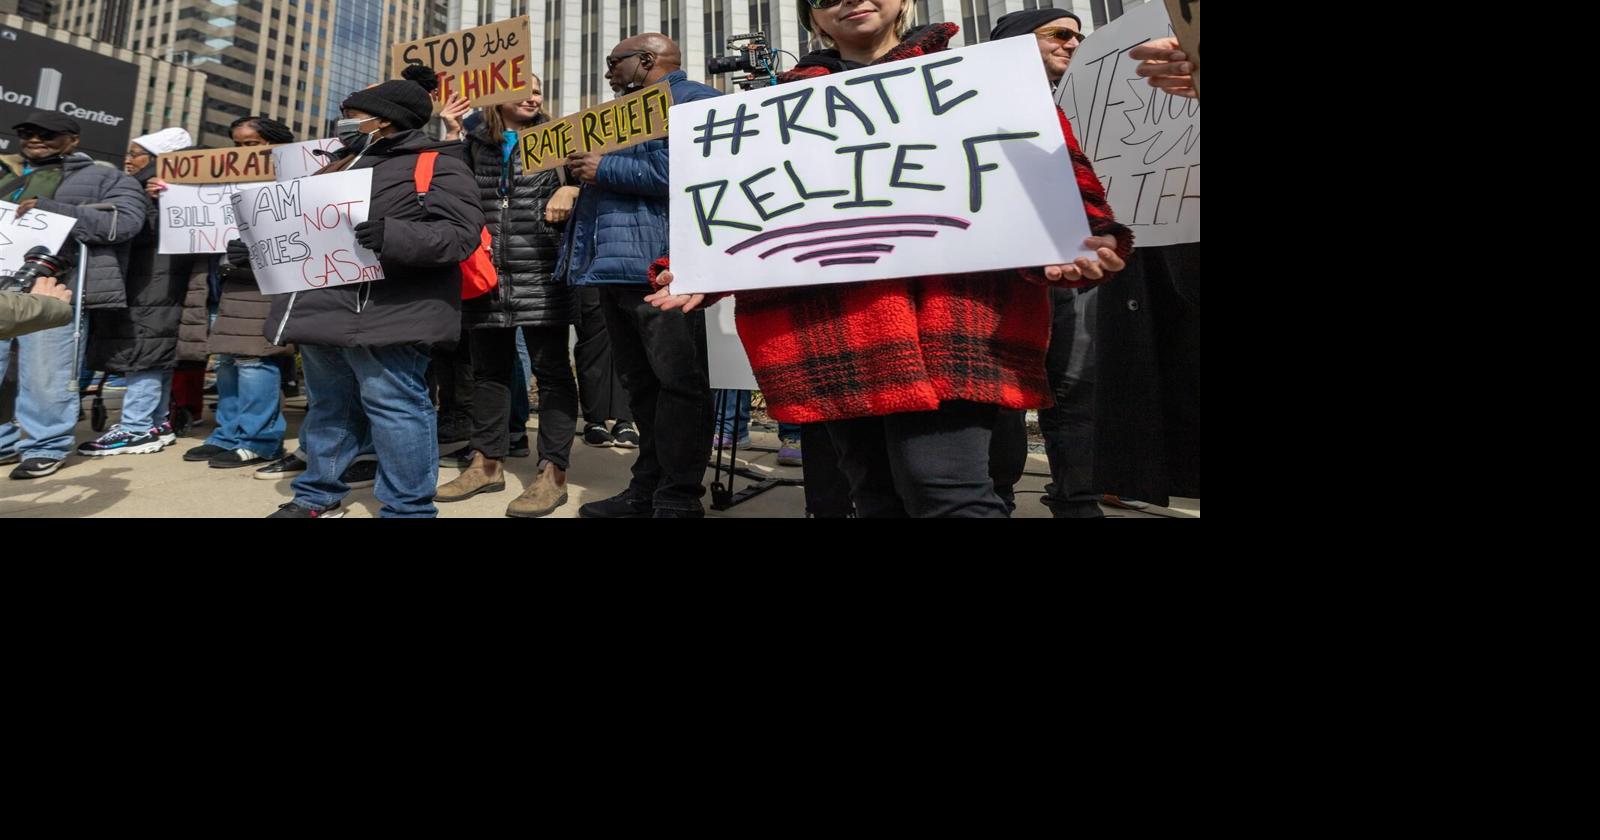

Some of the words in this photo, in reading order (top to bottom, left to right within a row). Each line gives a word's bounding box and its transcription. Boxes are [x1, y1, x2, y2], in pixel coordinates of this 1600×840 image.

[403, 32, 476, 69] STOP
[480, 28, 519, 58] the
[461, 54, 526, 101] HIKE
[59, 101, 124, 126] Center
[522, 119, 577, 170] RATE
[580, 88, 670, 152] RELIEF!
[693, 56, 979, 158] #RATE
[161, 155, 204, 179] NOT
[243, 149, 276, 176] AT
[252, 180, 302, 227] AM
[303, 200, 363, 235] NOT
[685, 131, 1041, 247] RELIEF
[167, 206, 215, 228] BILL
[303, 249, 361, 288] GAS
[362, 265, 384, 280] ATM
